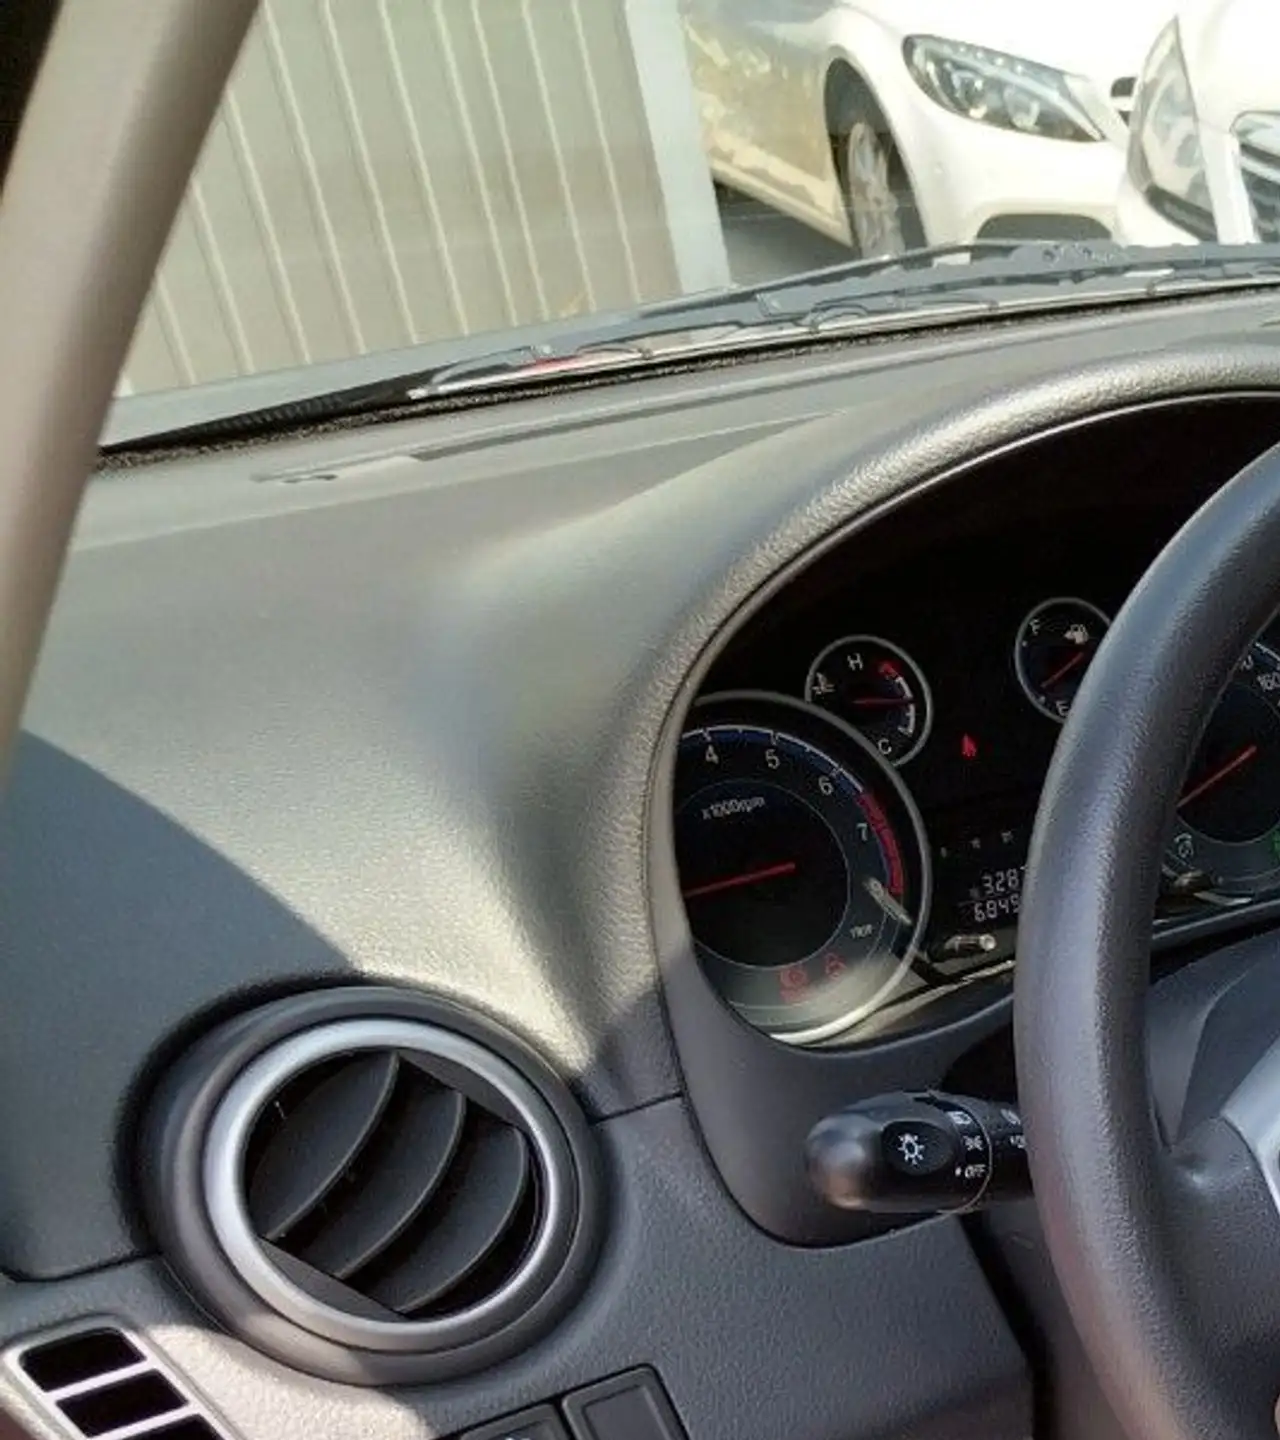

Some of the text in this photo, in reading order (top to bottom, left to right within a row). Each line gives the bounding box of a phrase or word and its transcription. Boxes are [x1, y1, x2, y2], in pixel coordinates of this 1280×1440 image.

[847, 652, 864, 671] H
[704, 744, 720, 765] 4
[877, 737, 893, 756] C
[765, 748, 780, 770] 5
[817, 775, 835, 797] 6
[856, 822, 869, 842] 7
[964, 1163, 987, 1179] OFF
